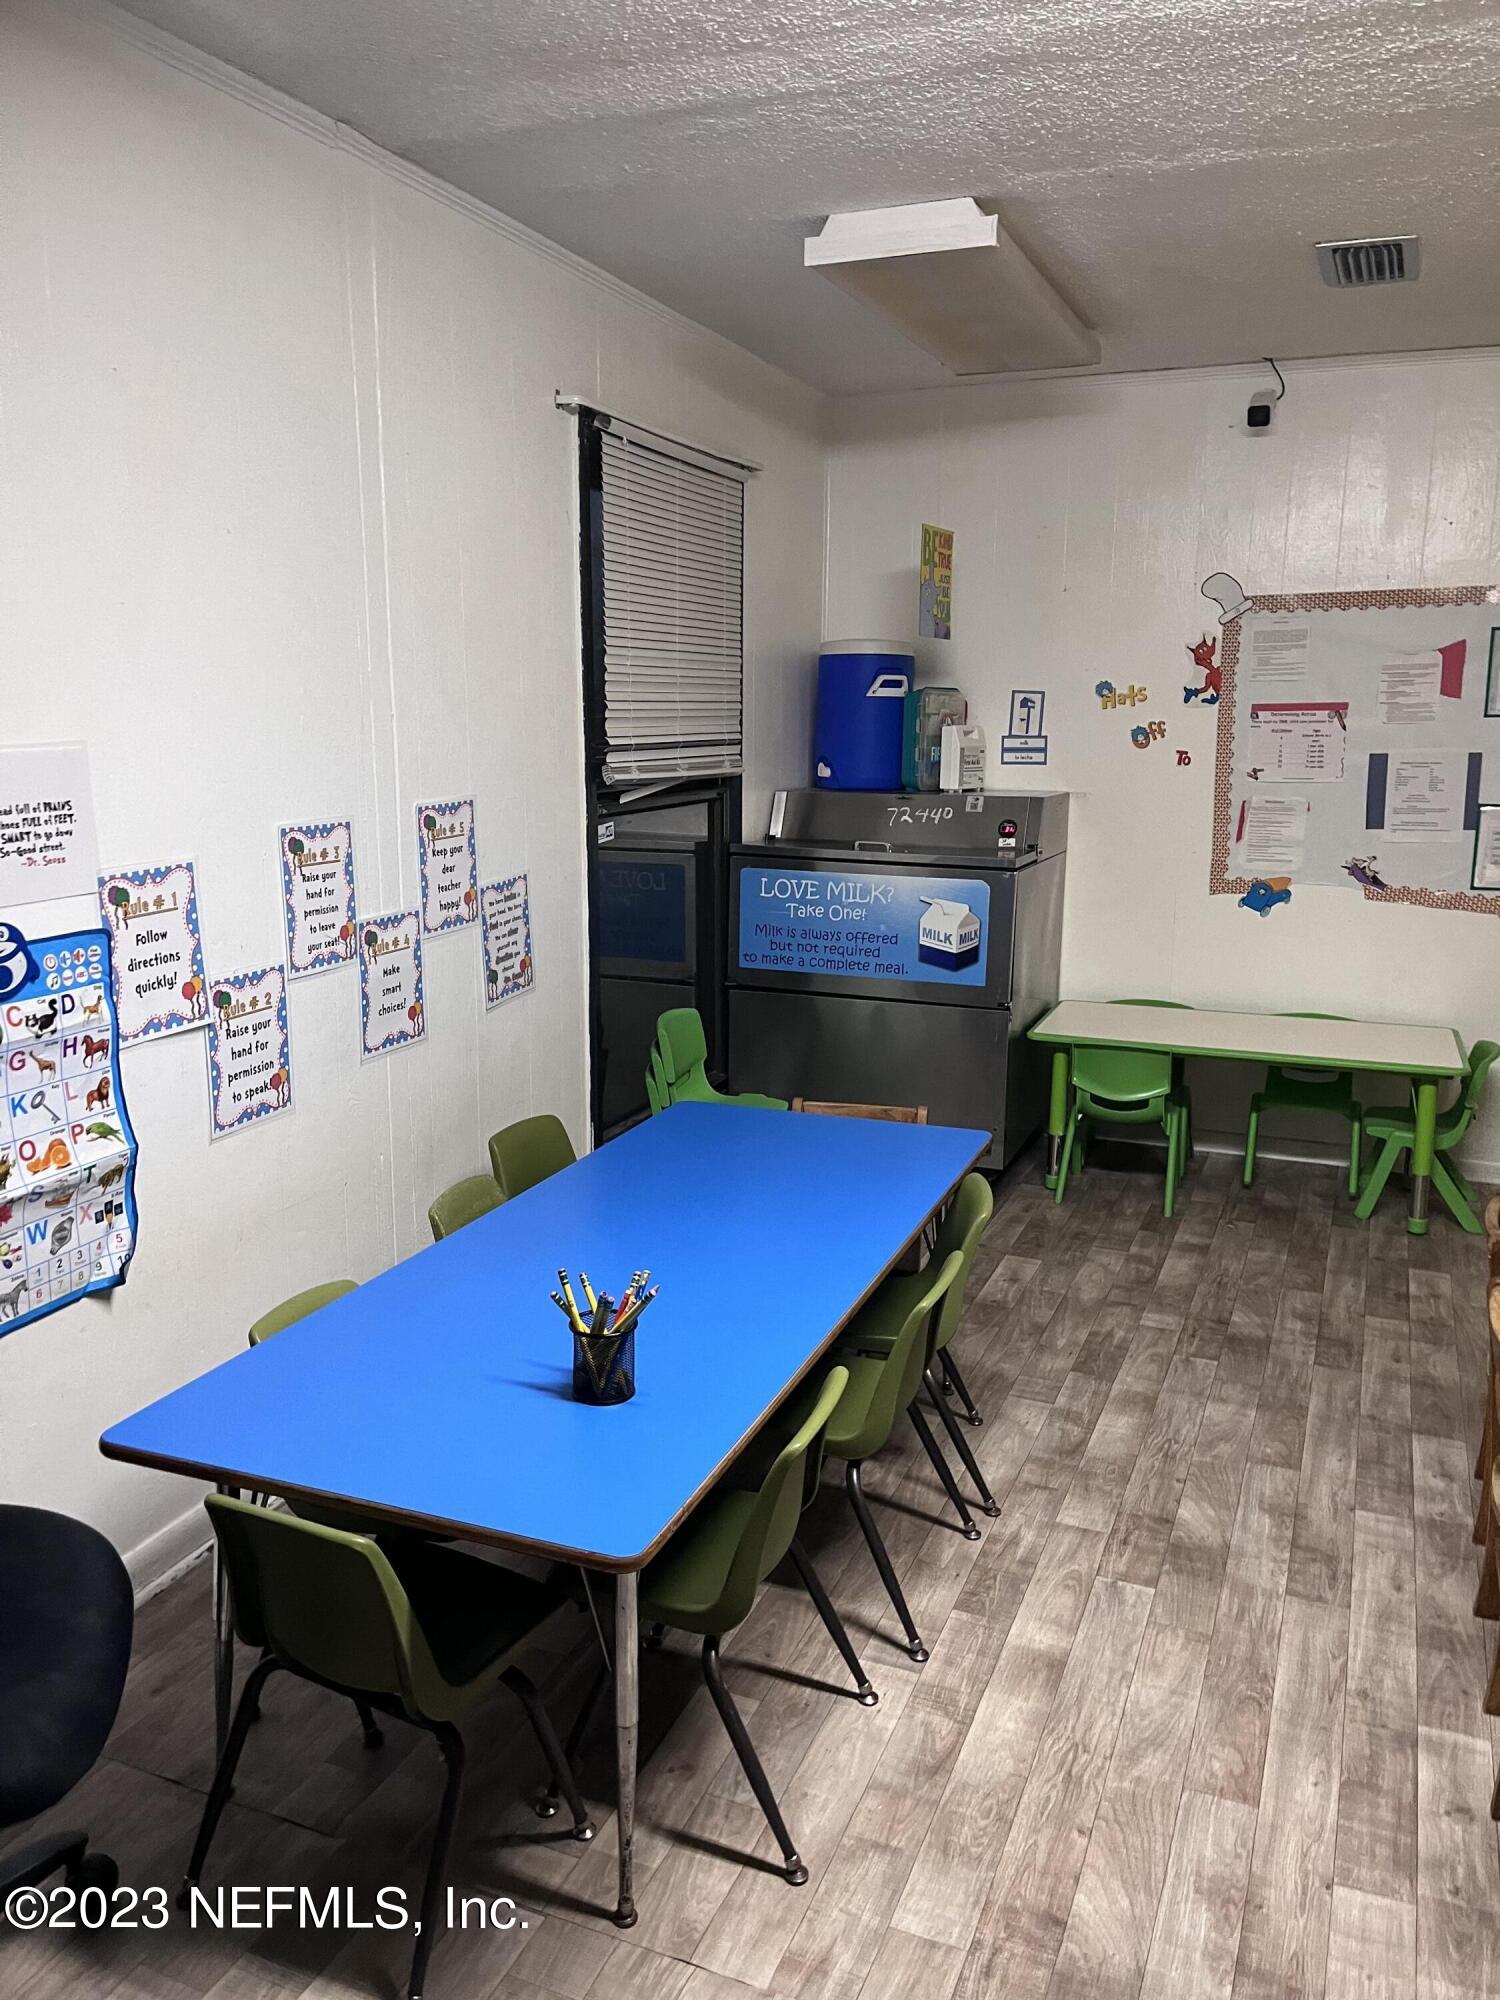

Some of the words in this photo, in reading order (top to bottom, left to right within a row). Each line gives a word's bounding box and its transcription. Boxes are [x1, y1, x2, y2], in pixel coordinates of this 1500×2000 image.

[1102, 684, 1147, 710] Hats
[1131, 720, 1166, 749] Off
[1176, 749, 1191, 766] To
[22, 817, 41, 828] FULL
[888, 807, 953, 826] 72440
[431, 824, 447, 839] Rule
[459, 822, 464, 833] 5
[297, 848, 317, 865] Rule
[333, 846, 340, 860] 3
[432, 847, 448, 858] Keep
[450, 845, 463, 857] your
[302, 873, 320, 883] Raise
[322, 871, 337, 883] your
[441, 864, 455, 874] dear
[306, 888, 323, 900] hand
[324, 887, 335, 897] for
[438, 880, 461, 893] teacher
[760, 878, 820, 900] LOVE
[827, 881, 895, 904] MILK?
[121, 897, 149, 916] Rule
[153, 895, 165, 910] #
[171, 891, 177, 906] 1
[304, 905, 339, 921] permission
[439, 896, 461, 912] happy!
[786, 903, 824, 918] Take
[829, 905, 867, 921] One!
[136, 930, 168, 946] Follow
[310, 925, 317, 935] to
[319, 922, 336, 932] leave
[755, 923, 783, 938] Milk
[787, 926, 796, 938] is
[800, 927, 842, 943] always
[846, 932, 899, 946] offered
[922, 927, 953, 946] MILK
[959, 927, 979, 946] MILK
[308, 942, 322, 955] your
[324, 936, 340, 949] seat!
[404, 934, 409, 946] 4
[770, 939, 794, 951] but
[797, 942, 819, 954] not
[823, 944, 881, 959] required
[128, 951, 181, 972] directions
[383, 964, 400, 977] Make
[744, 953, 758, 963] to
[762, 954, 794, 966] make
[798, 957, 805, 968] a
[810, 956, 870, 972] complete
[874, 962, 909, 975] meal.
[135, 972, 177, 998] quickly!
[382, 982, 402, 996] smart
[61, 993, 75, 1016] D
[223, 998, 246, 1018] Rule
[249, 996, 259, 1010] #
[264, 992, 272, 1005] 2
[379, 998, 406, 1016] choices!
[6, 1005, 24, 1028] C
[226, 1026, 249, 1040] Raise
[252, 1018, 271, 1035] your
[63, 1036, 78, 1058] H
[231, 1042, 252, 1060] hand
[255, 1040, 269, 1053] for
[9, 1050, 26, 1072] G
[228, 1060, 274, 1087] permission
[64, 1082, 79, 1101] L
[232, 1092, 242, 1103] to
[11, 1093, 28, 1118] K
[71, 1123, 84, 1145] P
[19, 1140, 37, 1161] O
[83, 1164, 97, 1183] T
[28, 1184, 45, 1202] S
[80, 1202, 94, 1225] X
[26, 1219, 48, 1245] W
[116, 1233, 123, 1243] 5
[77, 1250, 83, 1260] 3
[96, 1241, 102, 1251] 4
[36, 1267, 41, 1277] 1
[56, 1258, 63, 1269] 2
[95, 1261, 102, 1272] 9
[78, 1271, 84, 1281] 8
[36, 1288, 42, 1299] 6
